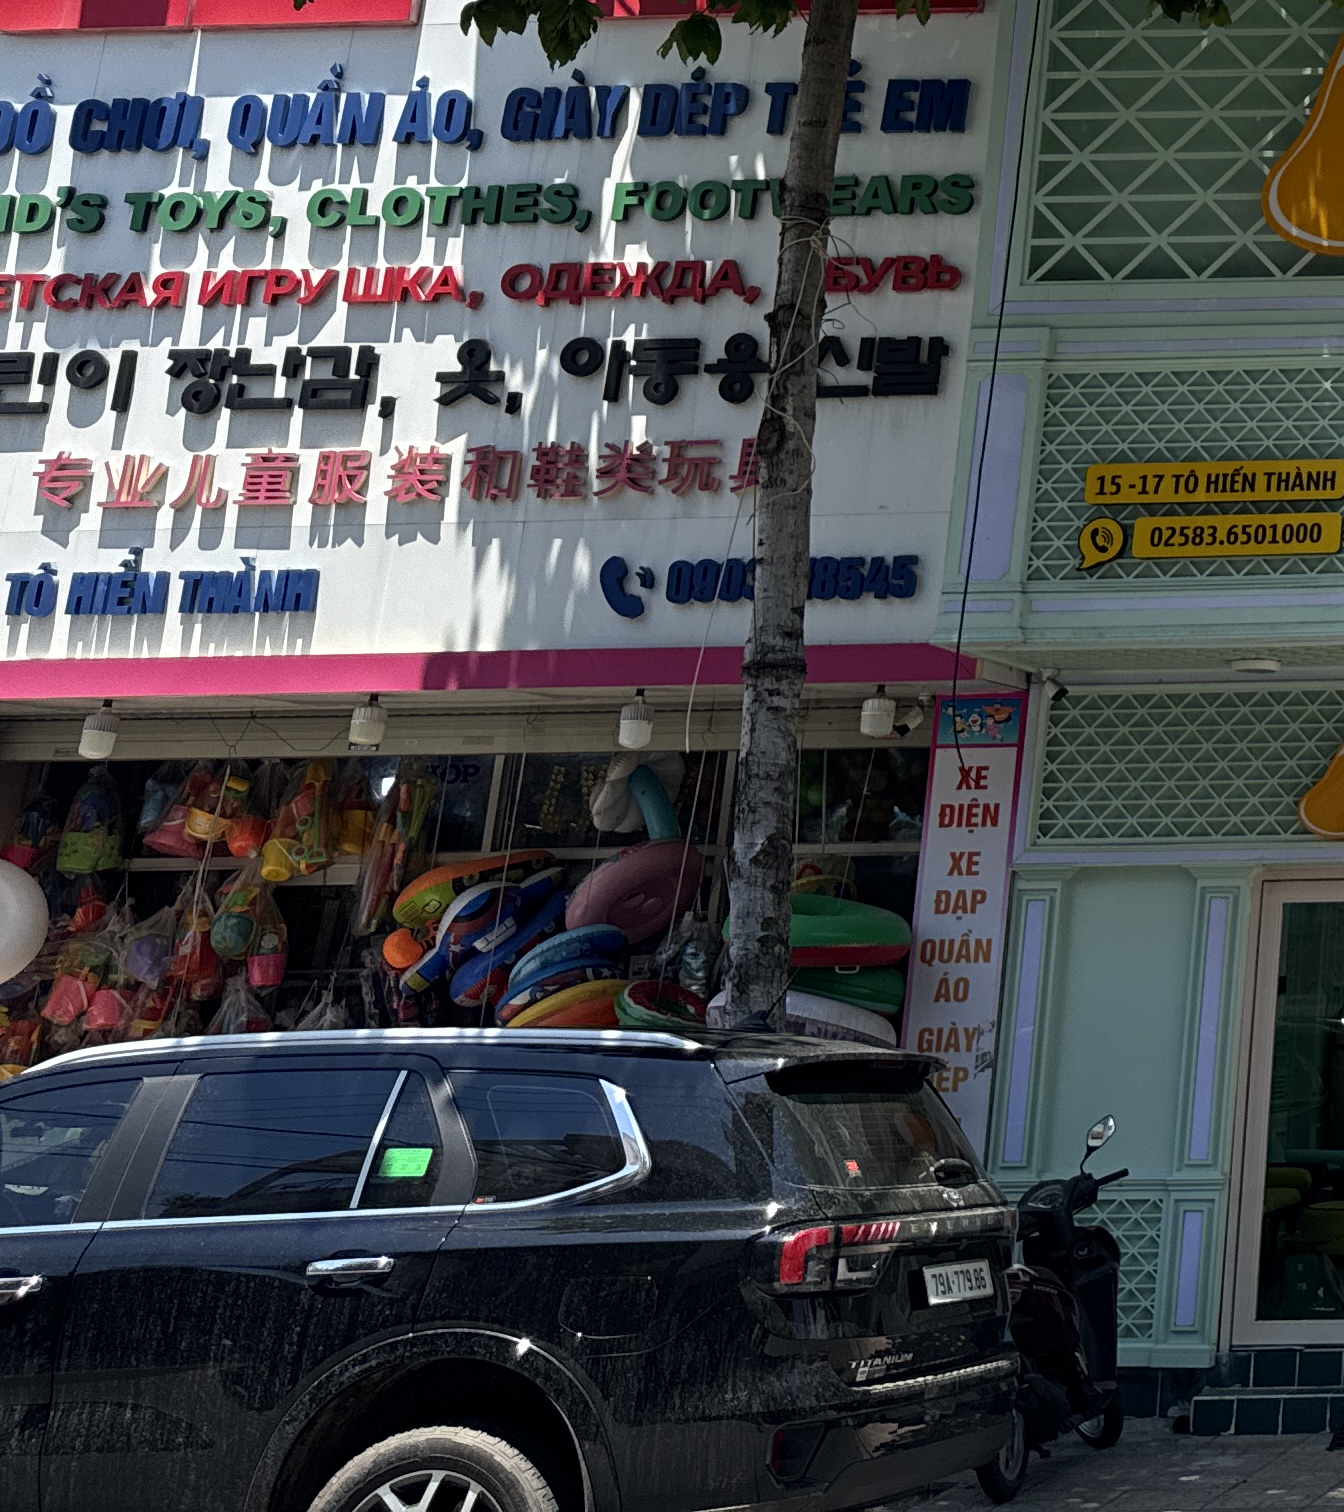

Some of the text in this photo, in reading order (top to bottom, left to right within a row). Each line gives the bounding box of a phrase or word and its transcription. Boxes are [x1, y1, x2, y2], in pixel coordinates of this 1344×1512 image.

[227, 62, 386, 155] QUẦN
[393, 75, 484, 151] ÁO,
[500, 68, 631, 142] GIÀY
[637, 66, 749, 137] DÉP
[764, 59, 865, 135] TẺ
[880, 78, 971, 134] EM
[124, 189, 288, 238] TOYS,
[306, 182, 592, 233] CLOTHES,
[611, 174, 976, 223] FOOTEARS
[500, 259, 761, 306] ОДЕЖДА,
[825, 254, 963, 295] БУВЬ
[165, 345, 399, 418] 장난감,
[434, 338, 523, 415] 옷,
[1095, 474, 1121, 496] 15
[1171, 469, 1199, 494] TÔ
[1206, 465, 1257, 493] HIẾN
[1264, 467, 1337, 492] THÀNH
[1150, 522, 1322, 548] 02583.6501000
[5, 561, 58, 617] TÔ
[178, 556, 321, 614] THÀNH
[956, 765, 990, 790] XE
[938, 798, 1000, 833] ĐIỆN
[947, 851, 982, 876] XE
[934, 889, 987, 920] ĐẠP
[920, 929, 993, 967] QUẦN
[934, 972, 970, 1003] ÁO
[917, 1021, 979, 1053] GIÀY
[848, 1352, 914, 1369] TITANIUM
